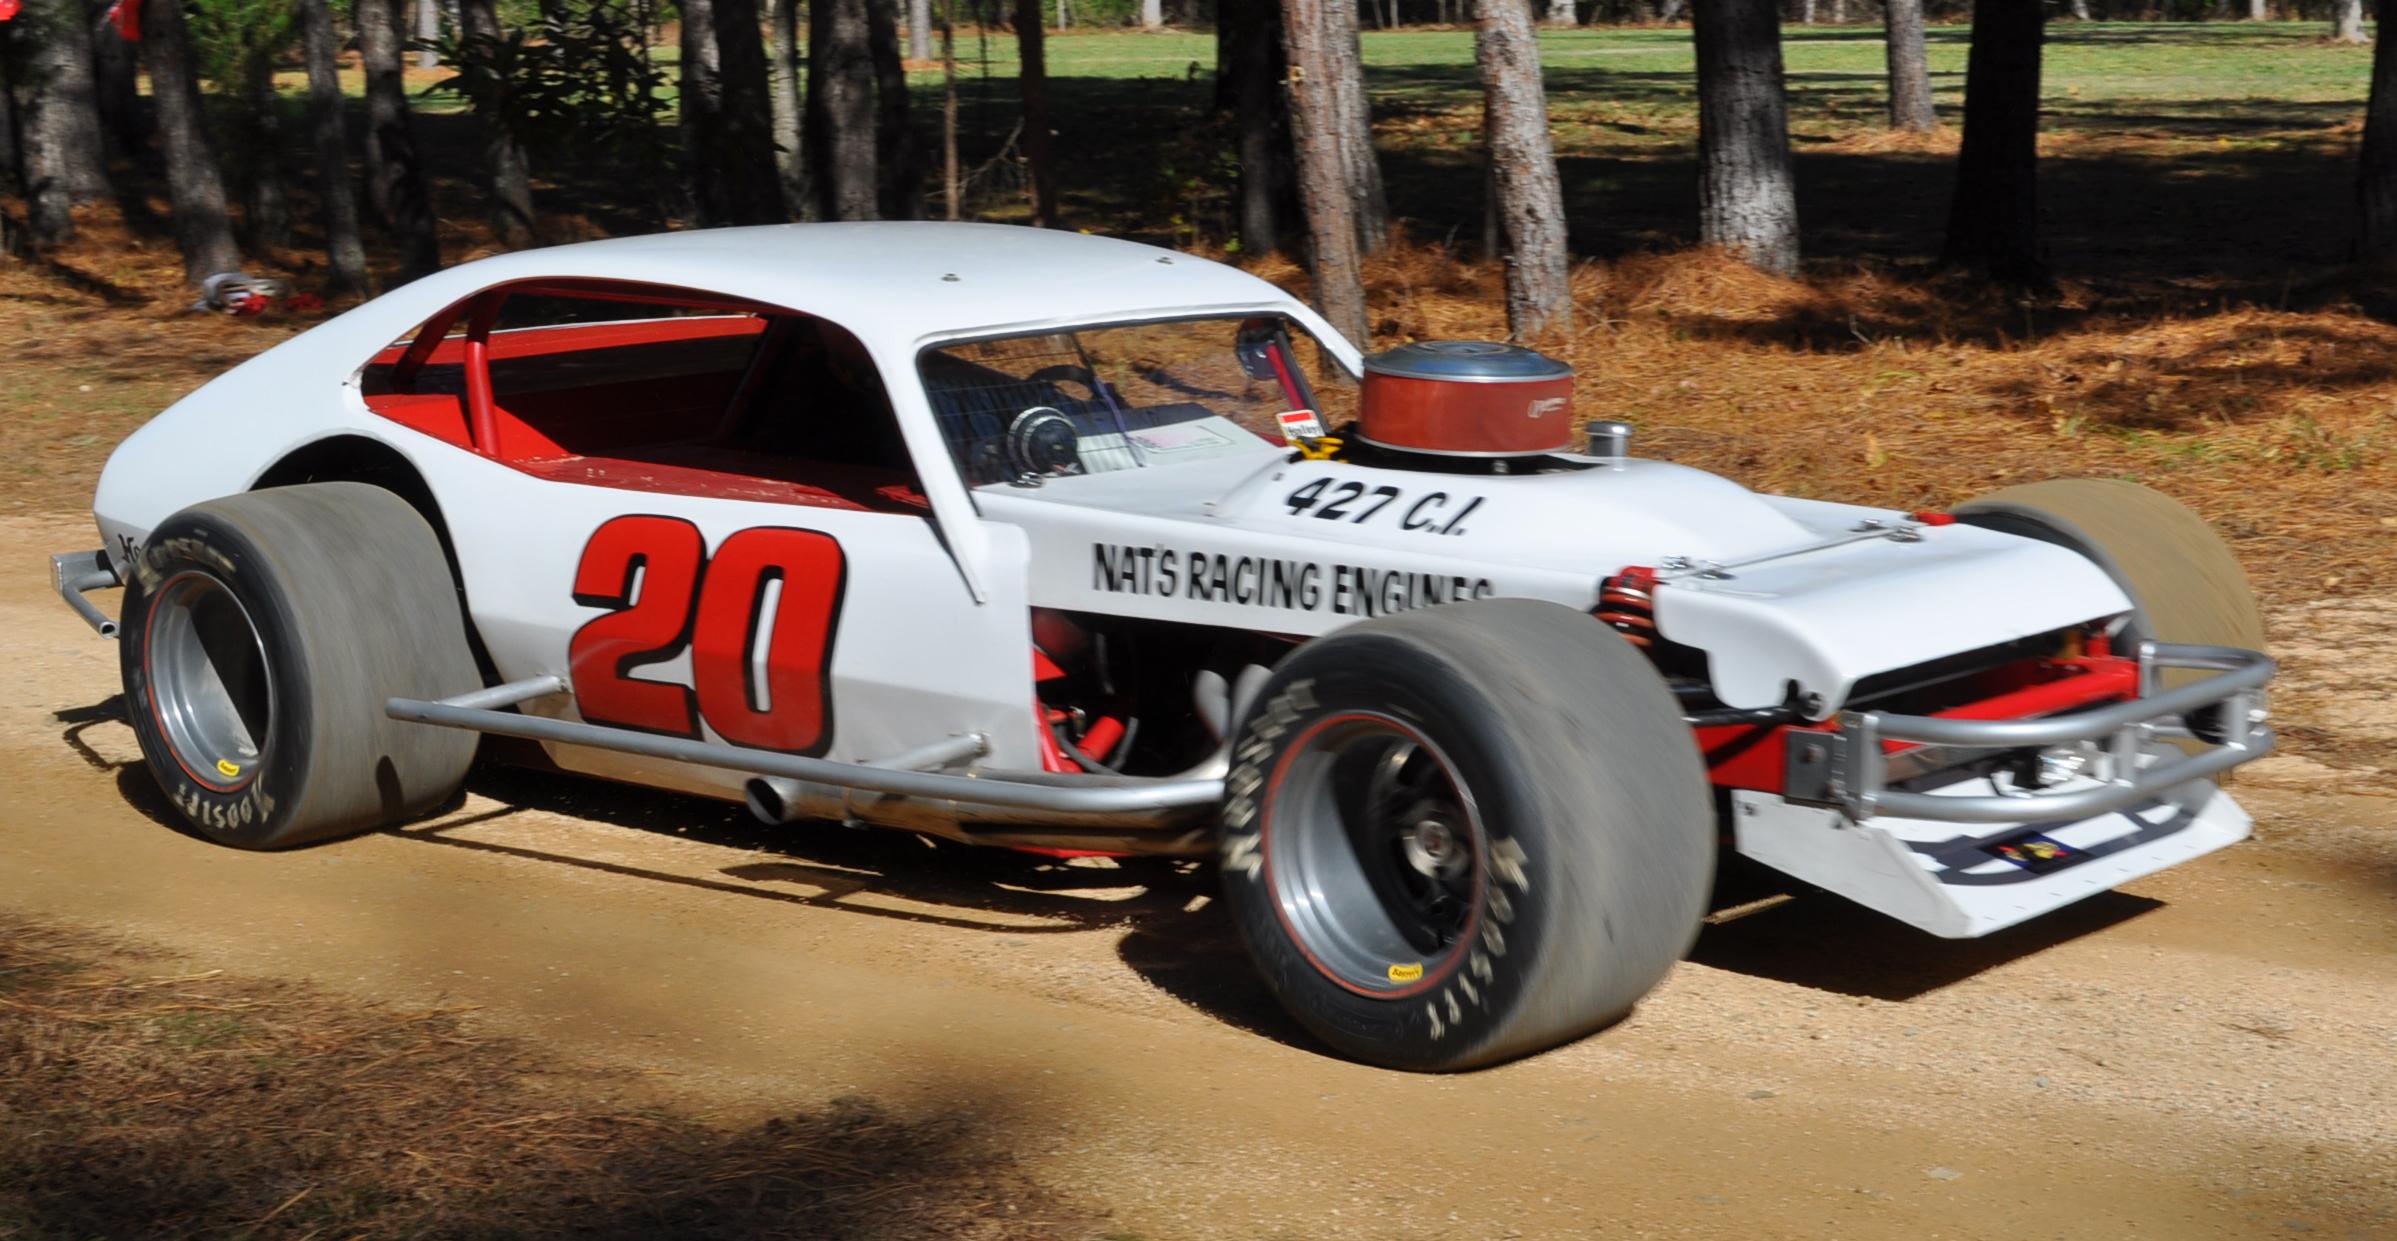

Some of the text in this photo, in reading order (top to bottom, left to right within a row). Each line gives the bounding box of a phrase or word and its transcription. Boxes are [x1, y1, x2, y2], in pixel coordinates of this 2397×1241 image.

[1285, 477, 1486, 535] 427 C.I.
[1093, 543, 1178, 597] NAT'S
[1187, 551, 1322, 611] RACING
[568, 513, 847, 758] 20
